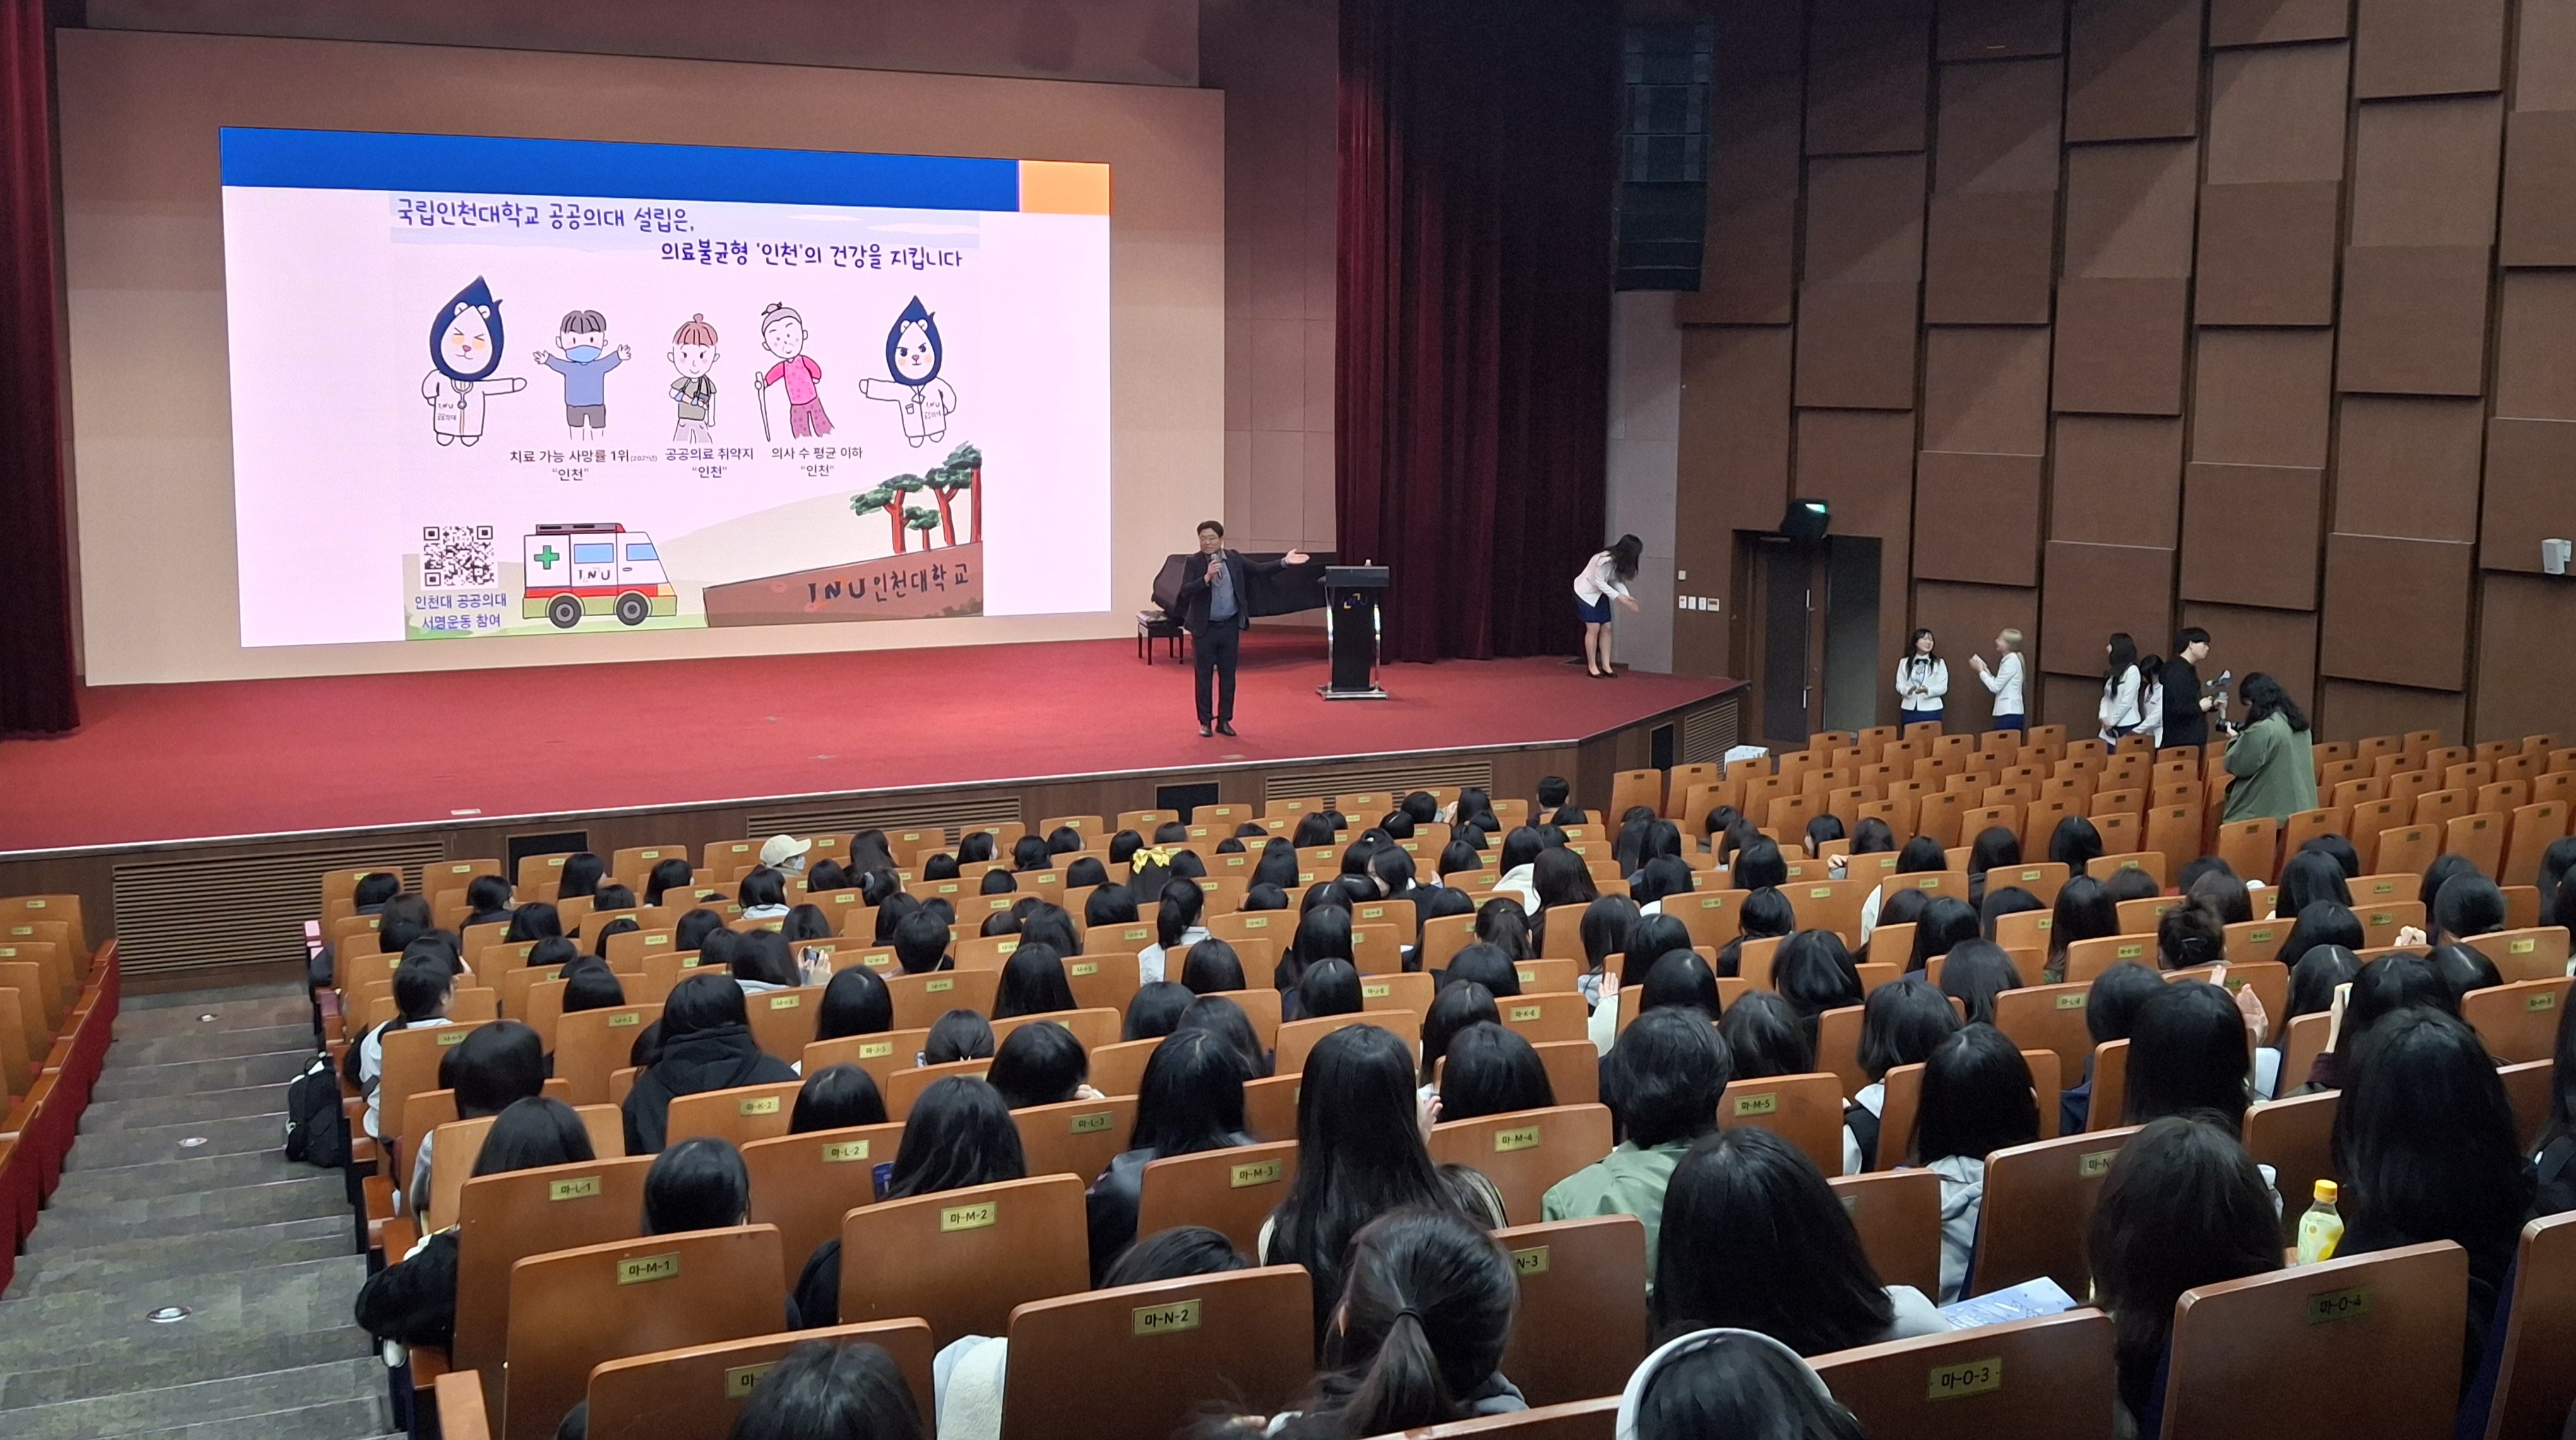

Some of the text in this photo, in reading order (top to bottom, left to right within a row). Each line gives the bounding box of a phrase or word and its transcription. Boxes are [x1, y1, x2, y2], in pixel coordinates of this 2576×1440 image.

[398, 198, 695, 233] 국립인천대학교 공공의대 설립은,
[662, 239, 748, 266] 의료불균형
[830, 244, 882, 269] 건강을
[890, 247, 962, 270] 지킵니다
[510, 450, 535, 463] 치료
[539, 449, 564, 463] 가능
[569, 449, 606, 463] 사망률
[665, 447, 753, 461] 공공의료 취약지
[772, 446, 863, 460] 의사 수 평균 이하
[874, 563, 969, 602] 인천대학교
[415, 593, 507, 609] 인천대 공공의대
[422, 613, 501, 630] 서명운동 참여
[746, 1101, 772, 1111] 마-K-2
[1741, 1098, 1770, 1110] 마-M-5
[1078, 1117, 1104, 1128] 마-L-3
[1502, 1133, 1532, 1144] 마-M-4
[831, 1146, 860, 1158] 마-L-2
[1239, 1166, 1273, 1181] 마-M-3
[561, 1182, 590, 1194] 마-L-1
[950, 1209, 987, 1224] 마-M-2
[628, 1260, 669, 1276] 마-M-1
[1145, 1309, 1189, 1328] 마-N-2
[1941, 1367, 1989, 1389] 마-O-3
